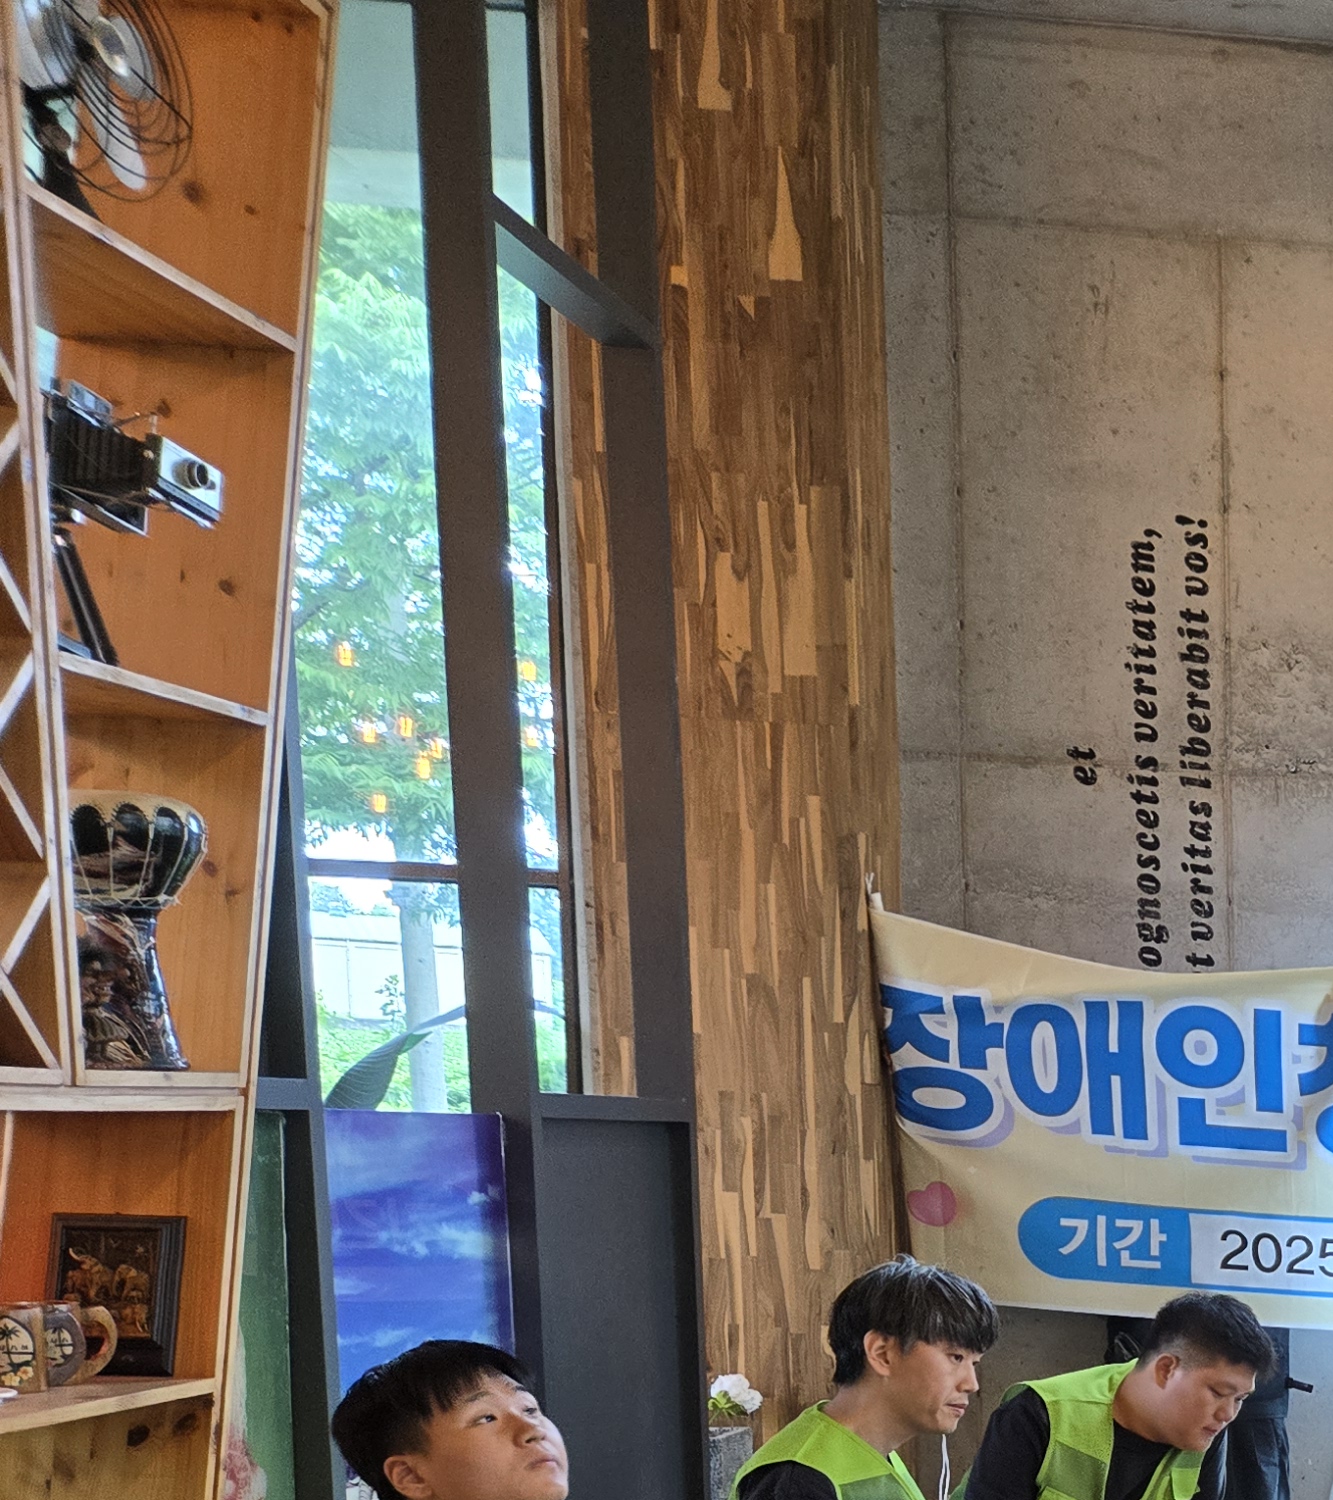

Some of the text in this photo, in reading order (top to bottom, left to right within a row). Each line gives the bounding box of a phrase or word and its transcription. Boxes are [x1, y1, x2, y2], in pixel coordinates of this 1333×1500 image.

[1174, 514, 1210, 600] vos!
[1124, 528, 1170, 968] ognoscetis veritatem,
[1177, 607, 1212, 790] liberabit
[1066, 745, 1098, 786] et
[1180, 799, 1214, 941] veritas
[1058, 1214, 1168, 1270] 기간
